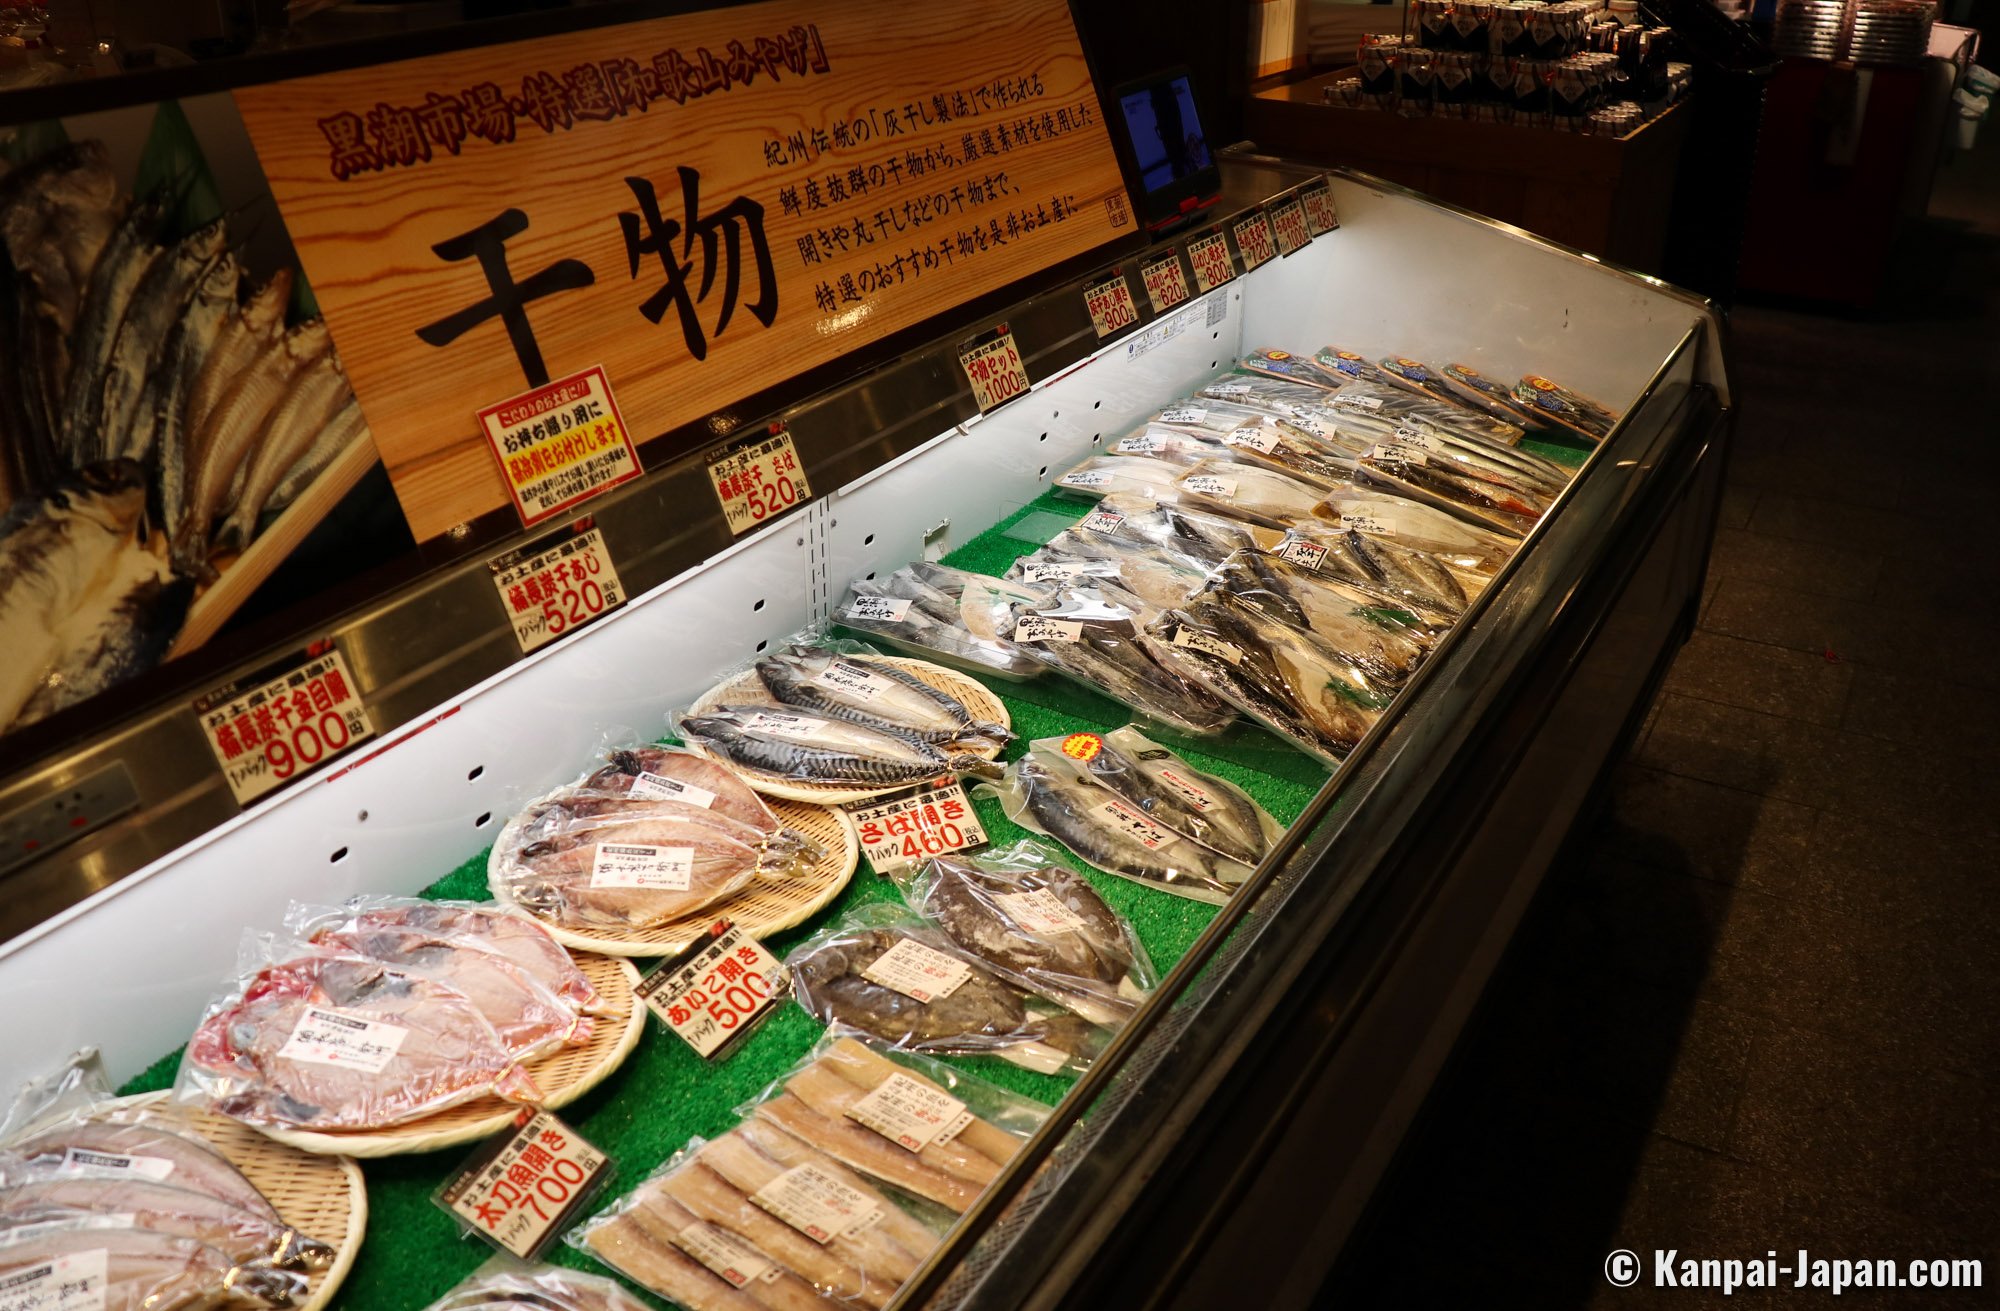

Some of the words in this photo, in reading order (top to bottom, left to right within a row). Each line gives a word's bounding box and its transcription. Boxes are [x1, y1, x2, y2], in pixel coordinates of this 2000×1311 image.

[763, 73, 1044, 168] 紀州伝統の「灰干し製法」で作られる
[779, 102, 1093, 217] 鮮度抜群の干物から、厳選素材を使用した
[797, 171, 1020, 266] 開きや丸干しなどの干物まで、
[415, 165, 778, 388] 干物
[815, 194, 1078, 313] 特選のおすすめ干物を是非お土産に
[1205, 260, 1229, 287] 800
[1249, 239, 1271, 264] 720
[1104, 304, 1130, 331] 900
[1160, 282, 1183, 306] 620
[967, 346, 1018, 385] 干物セット
[985, 370, 1021, 404] 1000
[503, 400, 604, 454] お持ち帰り用に
[717, 464, 763, 503] 備長炭干
[772, 448, 797, 476] さば
[746, 475, 796, 520] 520
[507, 546, 601, 614] 備長炭干あじ
[542, 579, 604, 634] 520
[213, 667, 351, 761] 備長炭干金目鯛
[228, 753, 268, 789] 1パック
[263, 710, 349, 779] 900
[348, 719, 365, 737] 円
[855, 786, 960, 822] お土産に最適!!
[858, 799, 965, 845] さば開き
[867, 842, 899, 862] 1パック
[901, 822, 964, 859] 460
[966, 833, 980, 845] 円
[653, 928, 742, 1004] お土産に最適!!
[667, 945, 760, 1027] あいご開き
[706, 970, 771, 1030] 500
[473, 1128, 567, 1231] 太刀魚開き
[517, 1158, 584, 1222] 700
